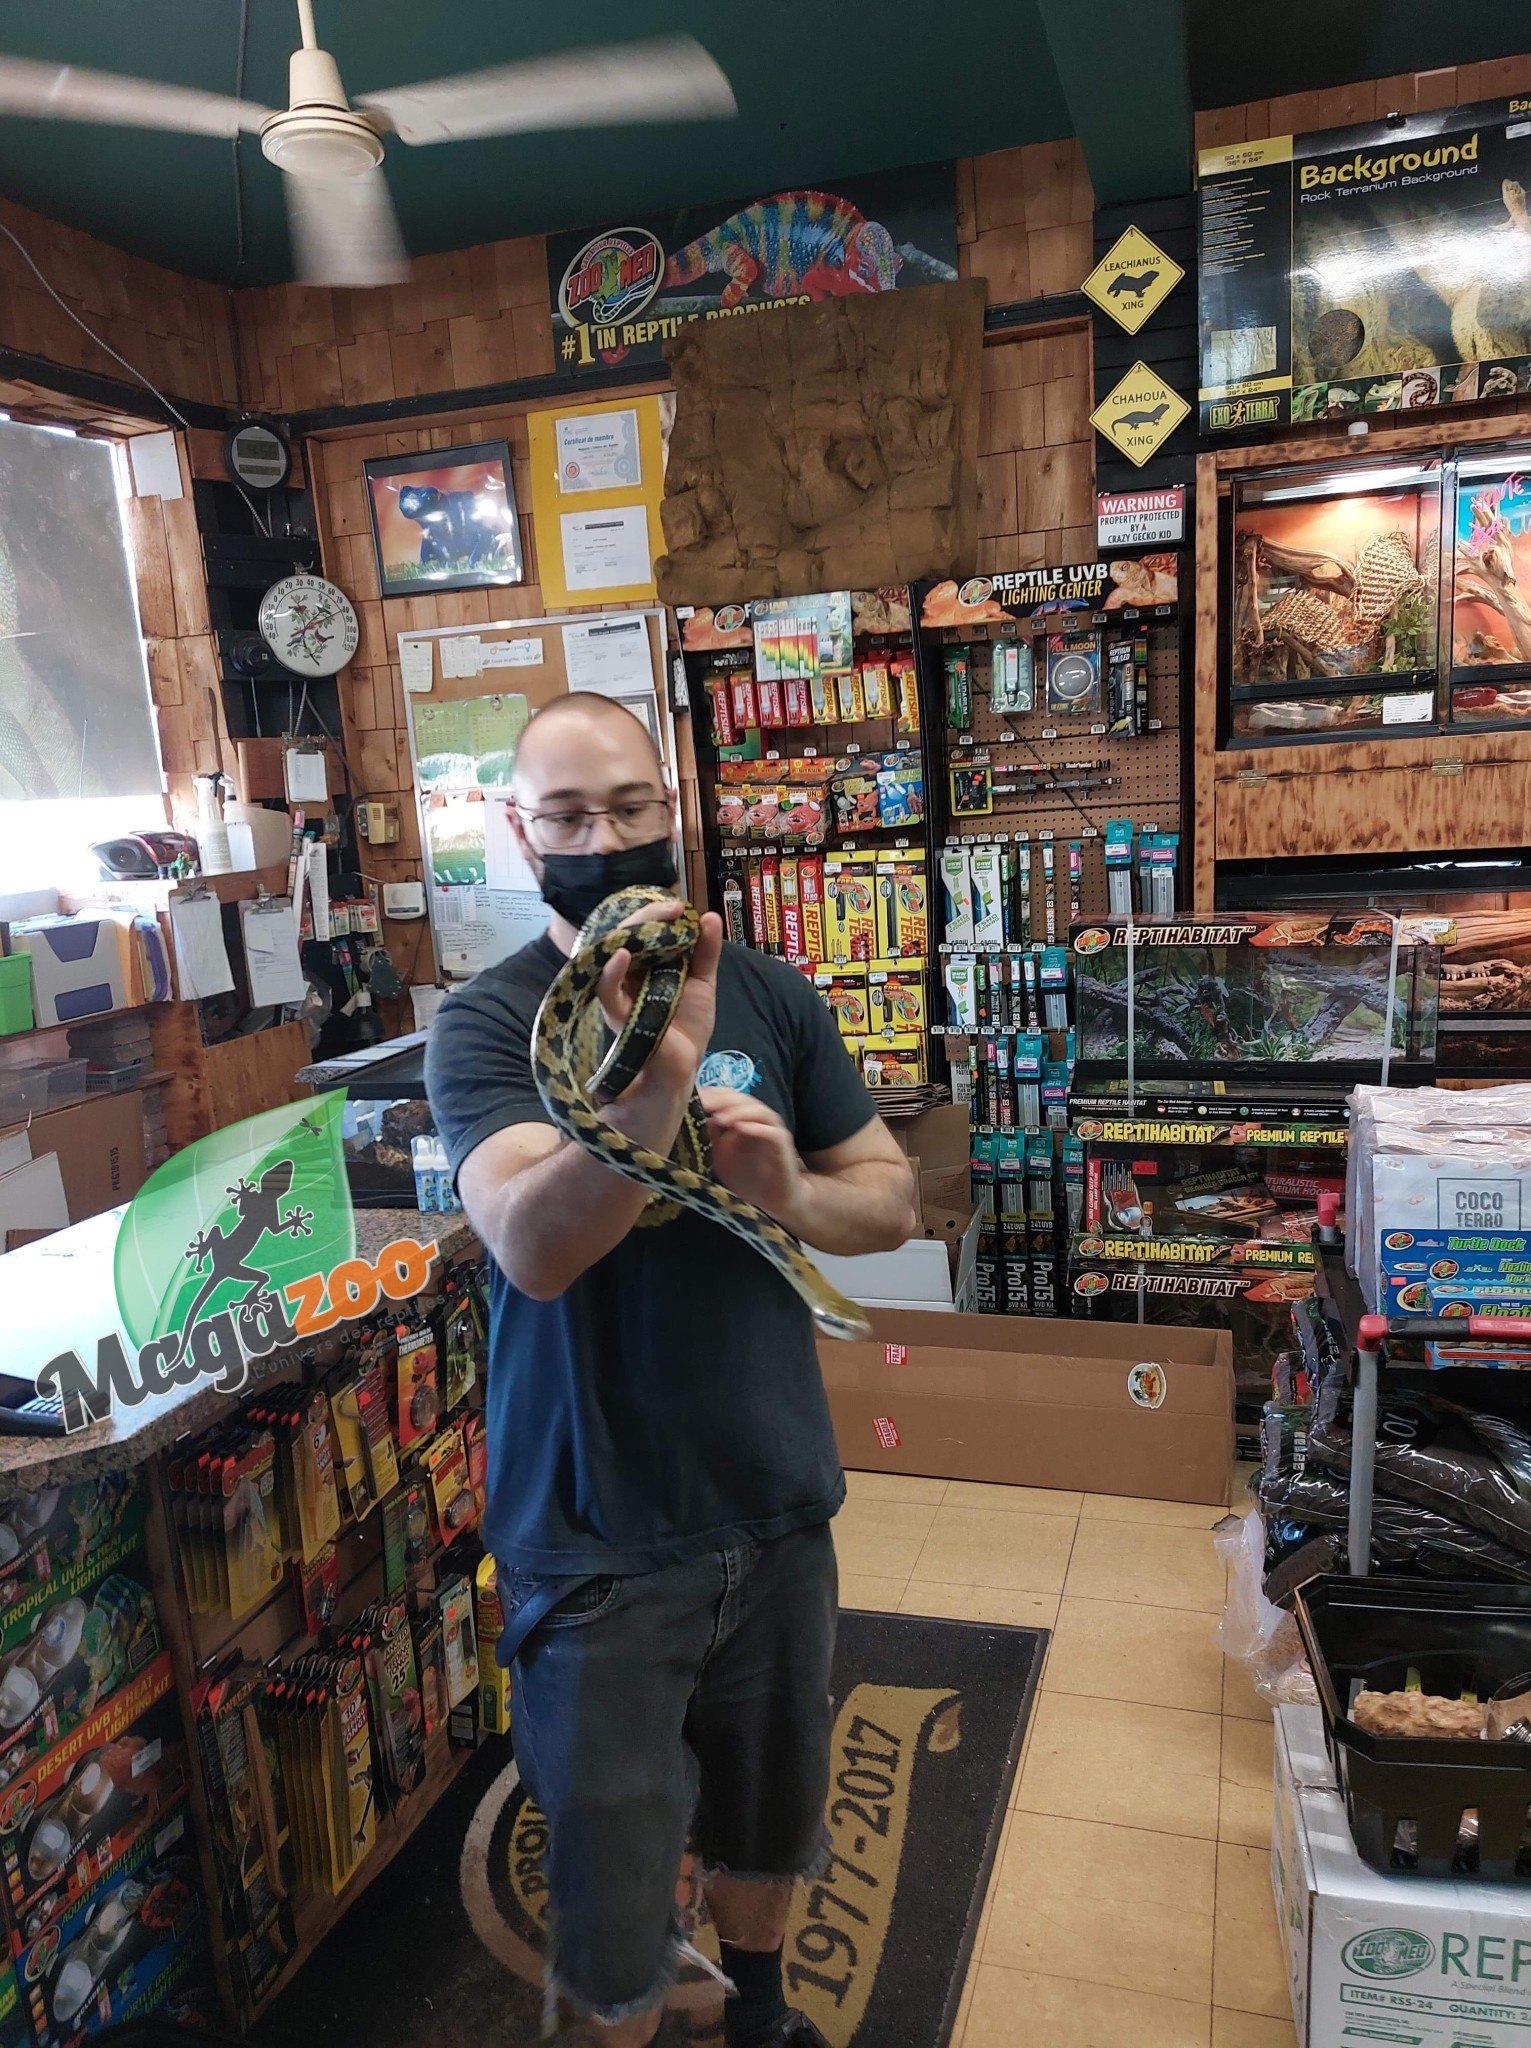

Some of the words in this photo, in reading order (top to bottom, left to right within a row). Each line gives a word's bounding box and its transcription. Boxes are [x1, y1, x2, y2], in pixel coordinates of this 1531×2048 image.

[1301, 133, 1478, 189] Background
[1301, 191, 1331, 203] Rock
[1335, 179, 1397, 197] Terrarium
[1401, 165, 1478, 186] Background
[1104, 256, 1161, 271] LEACHIANUS
[568, 264, 602, 309] ZOO
[618, 242, 656, 291] MED
[1122, 300, 1144, 311] XING
[561, 322, 596, 364] #1
[597, 328, 617, 350] IN
[623, 314, 699, 345] REPTI
[1112, 391, 1167, 405] CHAHOUA
[1212, 405, 1230, 427] EXO
[1245, 400, 1275, 422] TERRA
[1126, 435, 1154, 447] XING
[1102, 494, 1177, 514] WARNING
[1100, 515, 1137, 525] PROPERTY
[1140, 511, 1179, 522] PROTECTED
[1130, 524, 1140, 532] BY
[1142, 523, 1147, 531] A
[1108, 534, 1130, 543] CRAZY
[1132, 532, 1156, 541] GECKO
[1158, 530, 1172, 538] KID
[318, 582, 325, 590] 50
[993, 567, 1063, 592] REPTILE
[1069, 563, 1108, 580] UVB
[278, 587, 285, 595] 10
[328, 588, 335, 596] 60
[336, 596, 343, 604] 70
[1002, 582, 1056, 606] LIGHTING
[1059, 580, 1102, 598] CENTER
[1070, 642, 1096, 651] MOON
[852, 675, 862, 711] REPTISUN
[906, 674, 918, 722] REPTISUN
[718, 691, 731, 737] REPTISUN
[751, 886, 763, 934] REPTISUN
[765, 892, 776, 934] EPTISUN
[989, 1100, 997, 1126] DESERT
[1103, 1122, 1215, 1143] REPTIHABITAT
[1246, 1129, 1295, 1142] PREMIUM
[1300, 1131, 1345, 1143] REPTILE
[1265, 1176, 1318, 1187] ATURALISTIC
[1455, 1191, 1504, 1210] COCO
[1455, 1212, 1504, 1228] TERRO
[1104, 1238, 1214, 1262] REPTIHABITAT
[1448, 1237, 1488, 1250] Turtle
[1489, 1237, 1527, 1251] Dock
[1245, 1250, 1294, 1264] PREMIUM
[1006, 1262, 1028, 1302] ProT5
[1033, 1261, 1054, 1302] ProT5
[1020, 1301, 1028, 1309] Kit
[1046, 1301, 1054, 1309] Kit
[1479, 1303, 1531, 1317] Float
[879, 1417, 894, 1447] FRAGILE
[1382, 1412, 1420, 1440] 10
[69, 1550, 121, 1596] LIGHTING
[121, 1533, 138, 1557] KIT
[2, 1578, 60, 1630] TROPICAL
[61, 1559, 85, 1586] UVB
[86, 1554, 95, 1568] &
[104, 1693, 153, 1742] LIGHTING
[153, 1675, 171, 1699] KIT
[37, 1734, 86, 1783] DESERT
[86, 1713, 110, 1740] UVB
[113, 1706, 122, 1720] &
[126, 1675, 154, 1709] HEAT
[786, 1715, 903, 2010] 1977-2017
[1355, 1940, 1383, 1957] ZOO
[1399, 1944, 1425, 1960] MED
[1440, 1932, 1531, 1982] REP
[1458, 1980, 1495, 1992] Special
[1498, 1984, 1526, 1995] Blend
[1350, 1989, 1385, 2002] ITEM#
[1390, 1994, 1433, 2010] RSS-24
[1449, 2004, 1516, 2019] QUANTITY:
